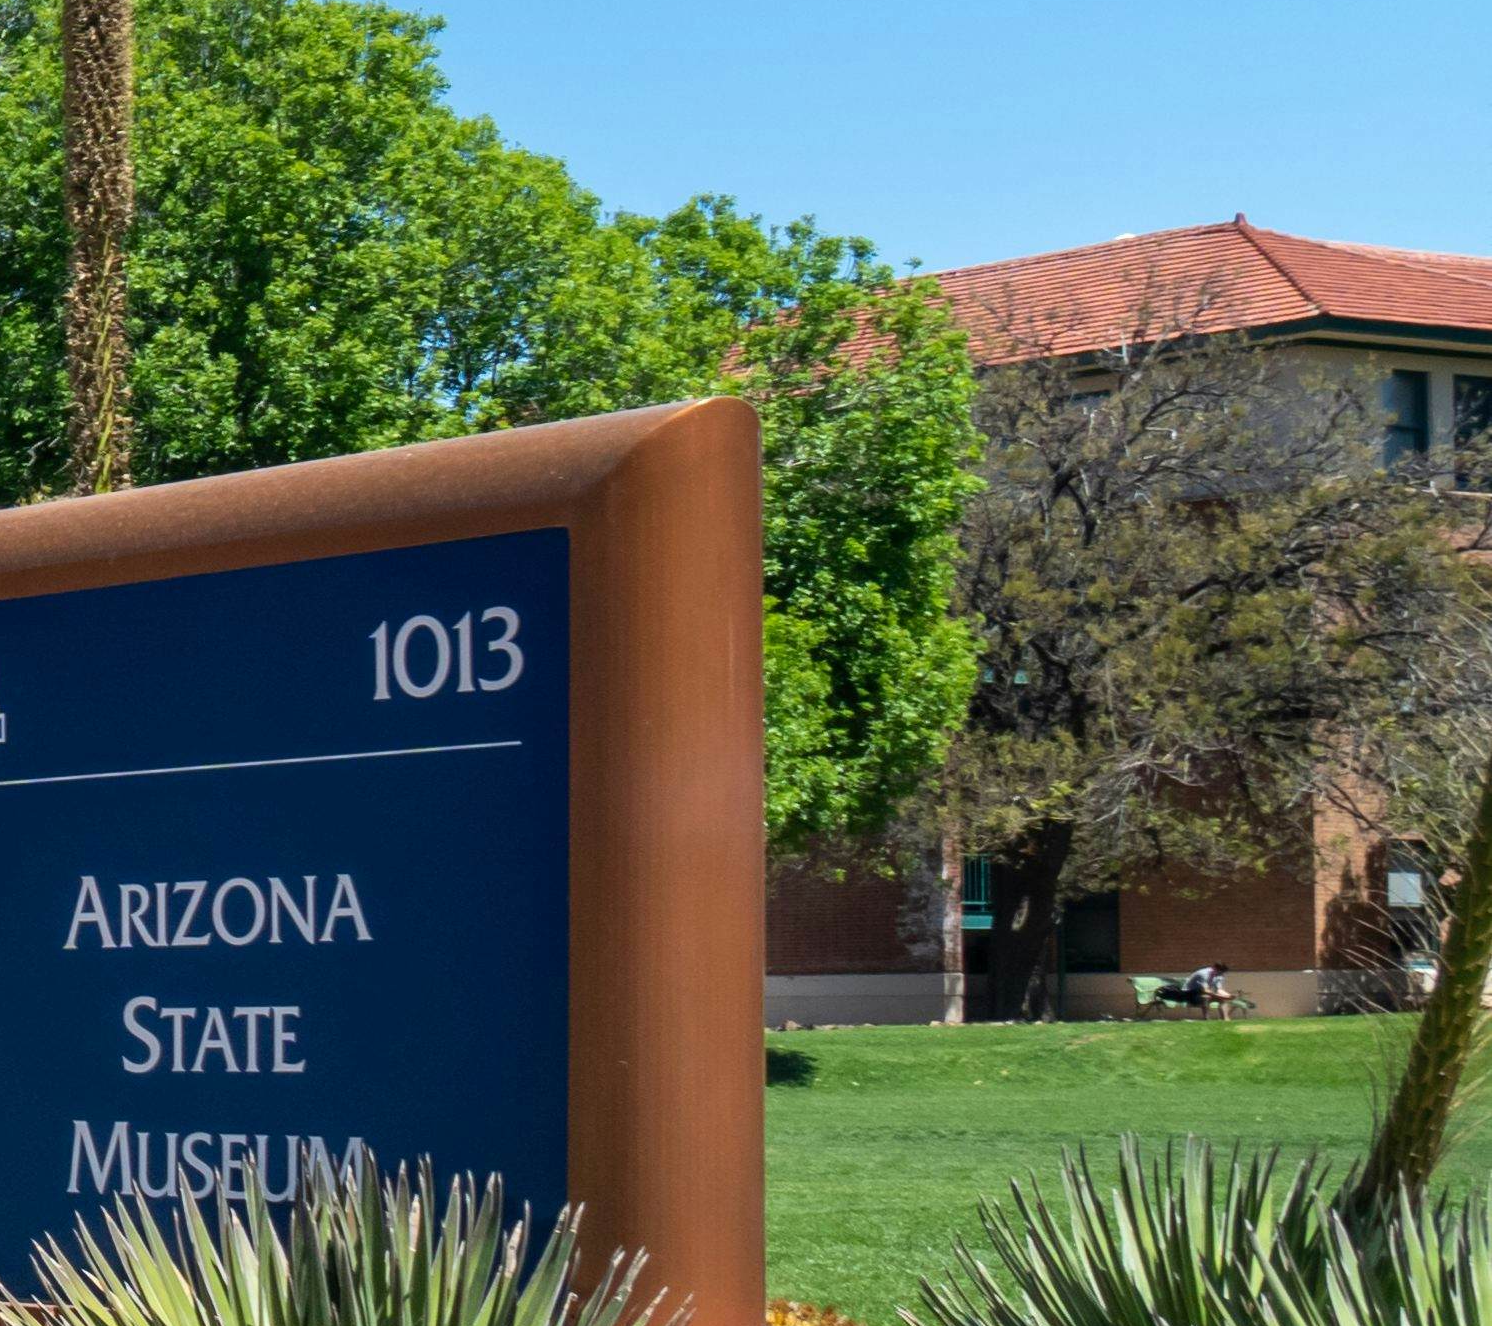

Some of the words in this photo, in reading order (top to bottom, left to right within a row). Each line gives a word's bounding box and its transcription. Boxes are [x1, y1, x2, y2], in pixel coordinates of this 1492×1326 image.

[368, 605, 524, 701] 1013
[62, 873, 373, 950] ARIZONA
[121, 995, 306, 1074] STATE
